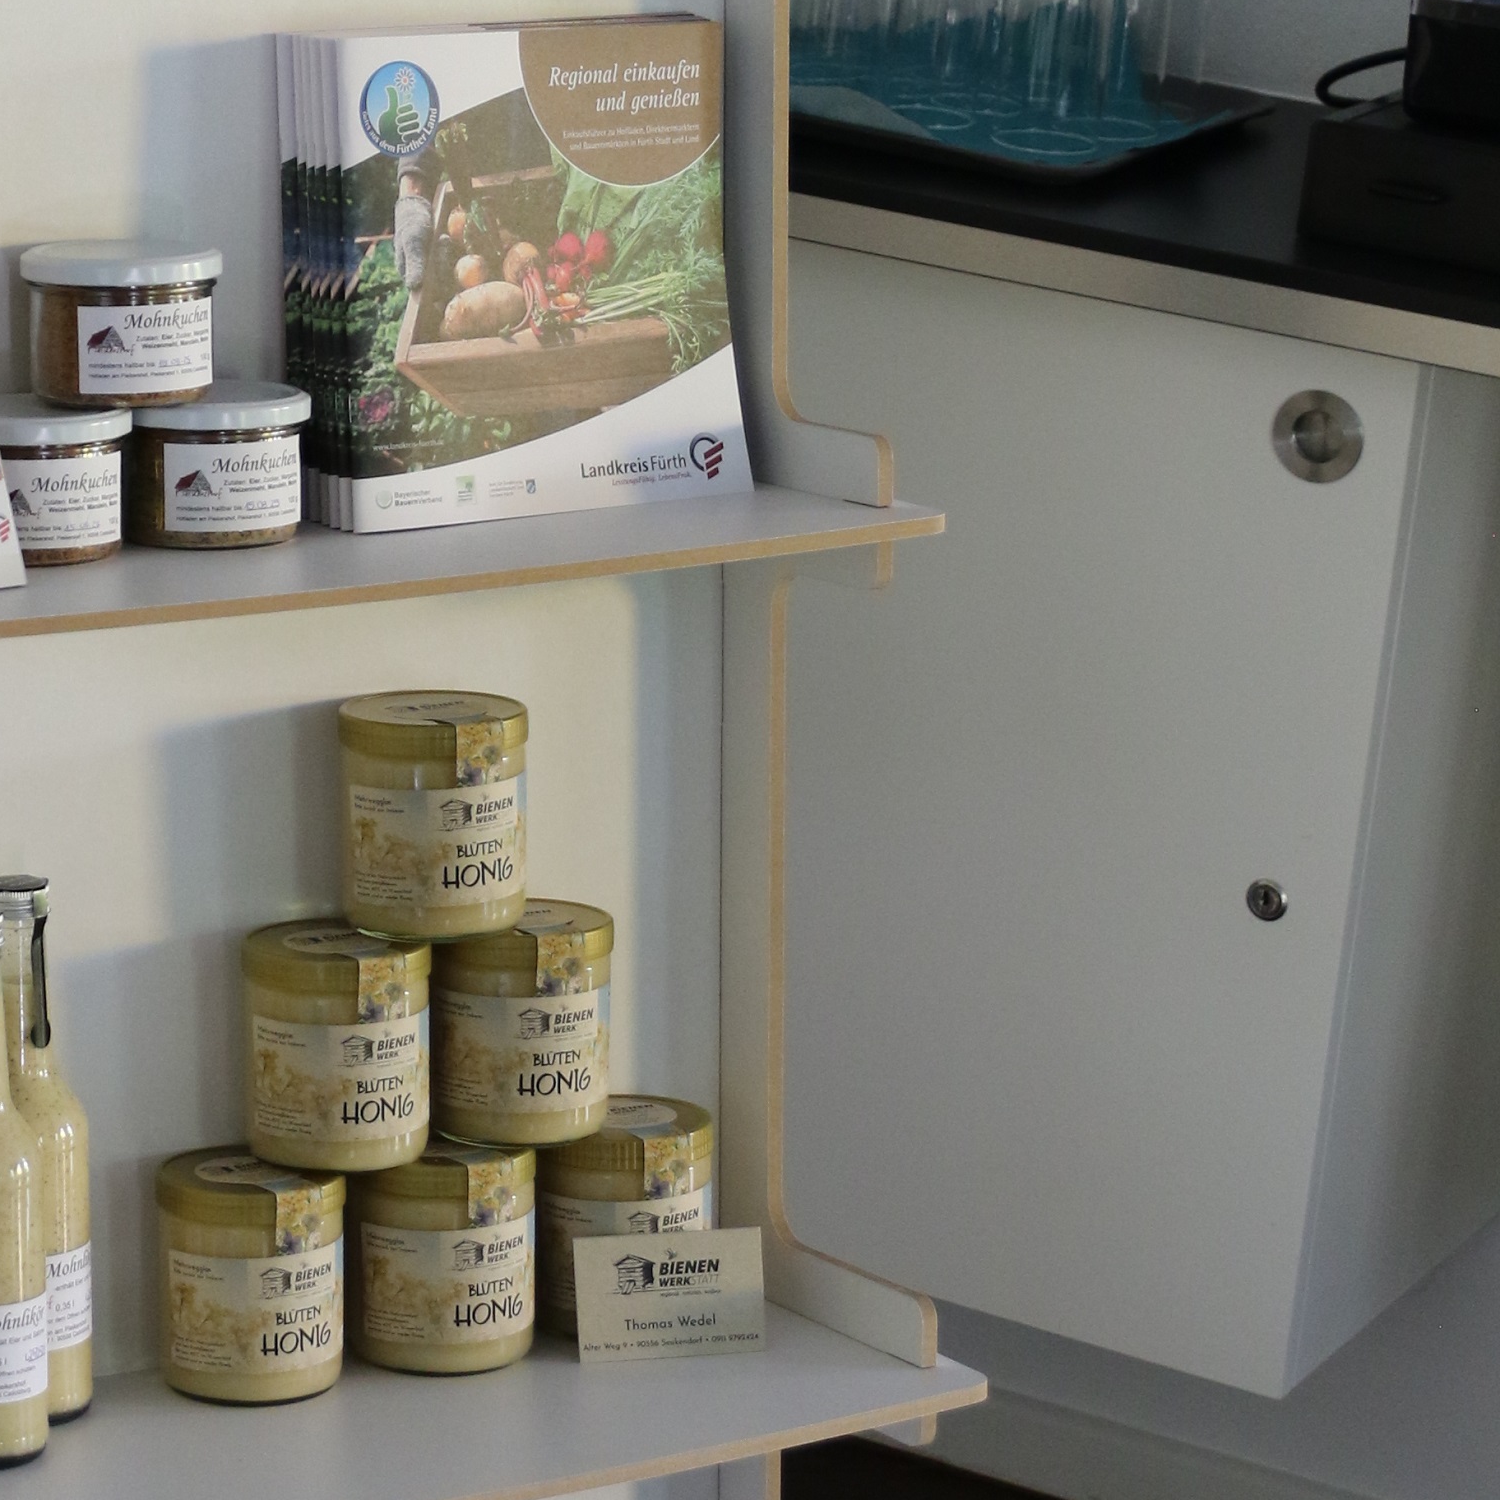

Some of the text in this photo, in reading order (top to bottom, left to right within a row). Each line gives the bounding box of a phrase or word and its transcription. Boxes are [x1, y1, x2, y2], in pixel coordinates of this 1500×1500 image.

[548, 59, 700, 91] Regional einkaufen
[595, 88, 700, 115] und genießen
[379, 140, 396, 154] dem
[396, 134, 427, 154] Fürther
[423, 108, 438, 136] Land
[124, 305, 209, 330] Mohnkuchen
[212, 449, 297, 474] Mohnkuchen
[580, 453, 687, 478] Landkreis Fürth
[31, 469, 118, 493] Mohnkuchen
[476, 796, 514, 815] BIENEN
[456, 838, 503, 859] BLÜTEN
[441, 855, 514, 890] HONIG
[554, 1008, 594, 1025] BIENEN
[377, 1032, 416, 1051] BIENEN
[532, 1049, 581, 1067] BLÜTEN
[356, 1075, 404, 1095] BLÜTEN
[517, 1067, 592, 1097] HONIG
[340, 1092, 414, 1125] HONIG
[662, 1207, 700, 1227] BIENEN
[487, 1234, 524, 1254] BIENEN
[295, 1261, 333, 1282] BIENEN
[659, 1258, 720, 1276] BIENEN
[468, 1276, 514, 1297] BLÜTEN
[659, 1274, 720, 1288] WERKSTATT
[275, 1305, 322, 1326] BLÜTEN
[454, 1293, 523, 1327] HONIG
[624, 1313, 716, 1331] Thomas Wedel
[261, 1321, 332, 1356] HONIG
[604, 1342, 620, 1350] Weg
